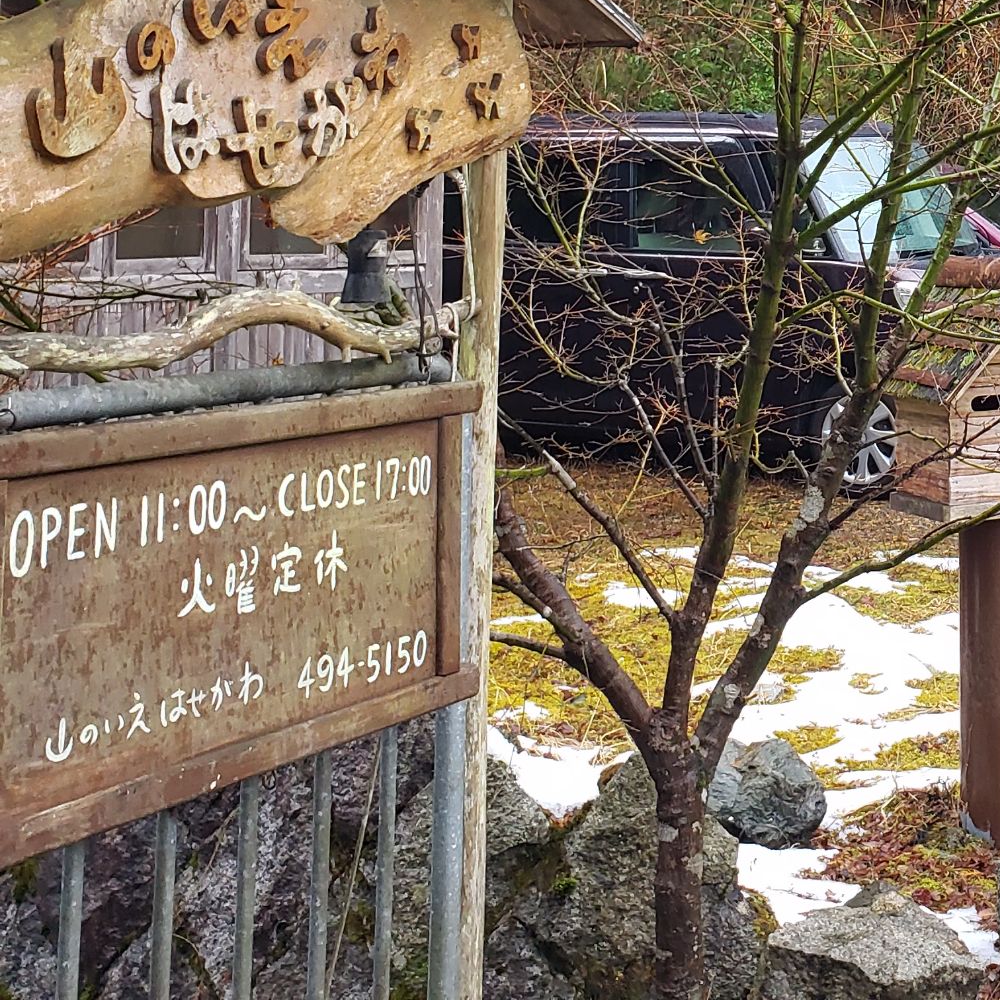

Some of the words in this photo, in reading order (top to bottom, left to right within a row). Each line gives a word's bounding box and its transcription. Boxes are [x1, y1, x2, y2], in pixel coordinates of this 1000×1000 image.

[151, 4, 411, 188] はせがわ
[9, 498, 117, 577] OPEN
[140, 480, 227, 547] 11:00
[278, 462, 367, 519] CLOSE
[375, 455, 432, 500] 17:00
[178, 530, 348, 617] 火曜定休
[298, 630, 427, 698] 494-5150
